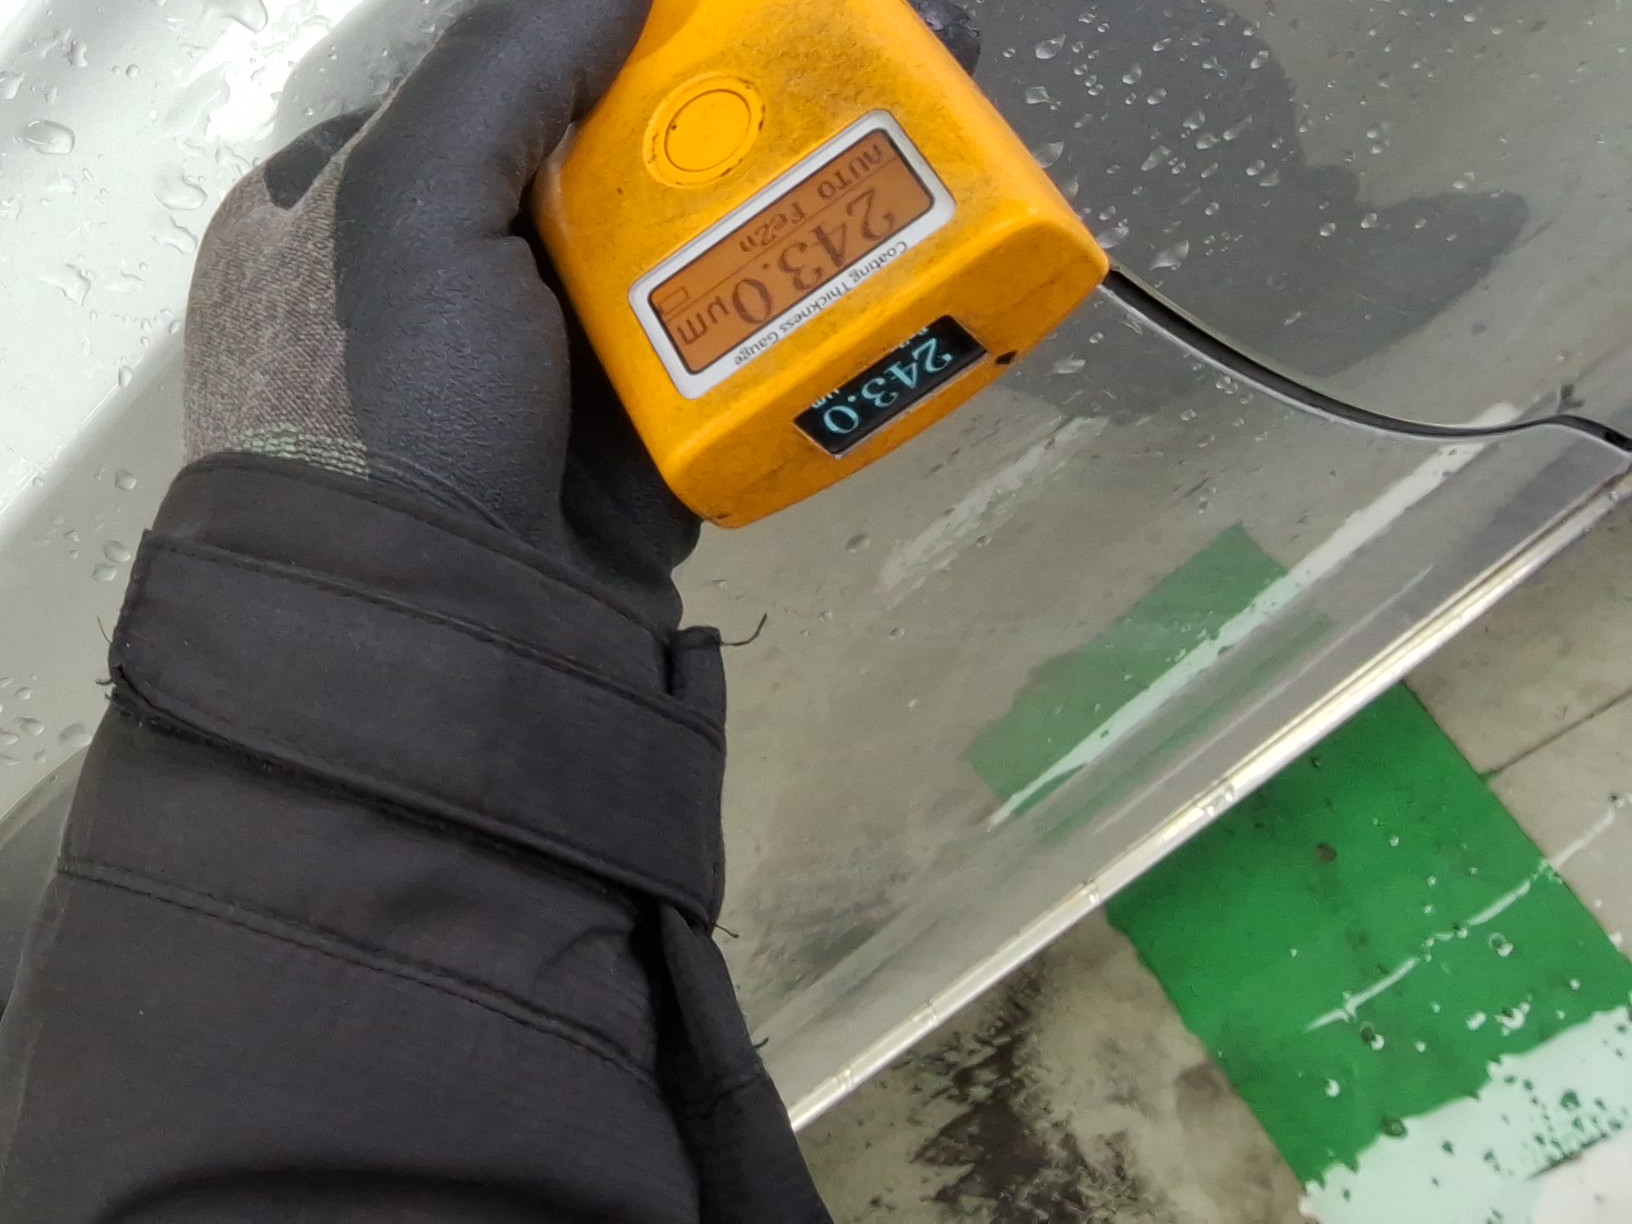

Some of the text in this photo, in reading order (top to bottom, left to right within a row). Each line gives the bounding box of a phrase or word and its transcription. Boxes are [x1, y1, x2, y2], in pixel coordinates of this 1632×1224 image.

[738, 143, 883, 254] AUTO FeZn
[732, 240, 909, 366] Coating Thickness Gauge
[823, 337, 955, 435] 243.0
